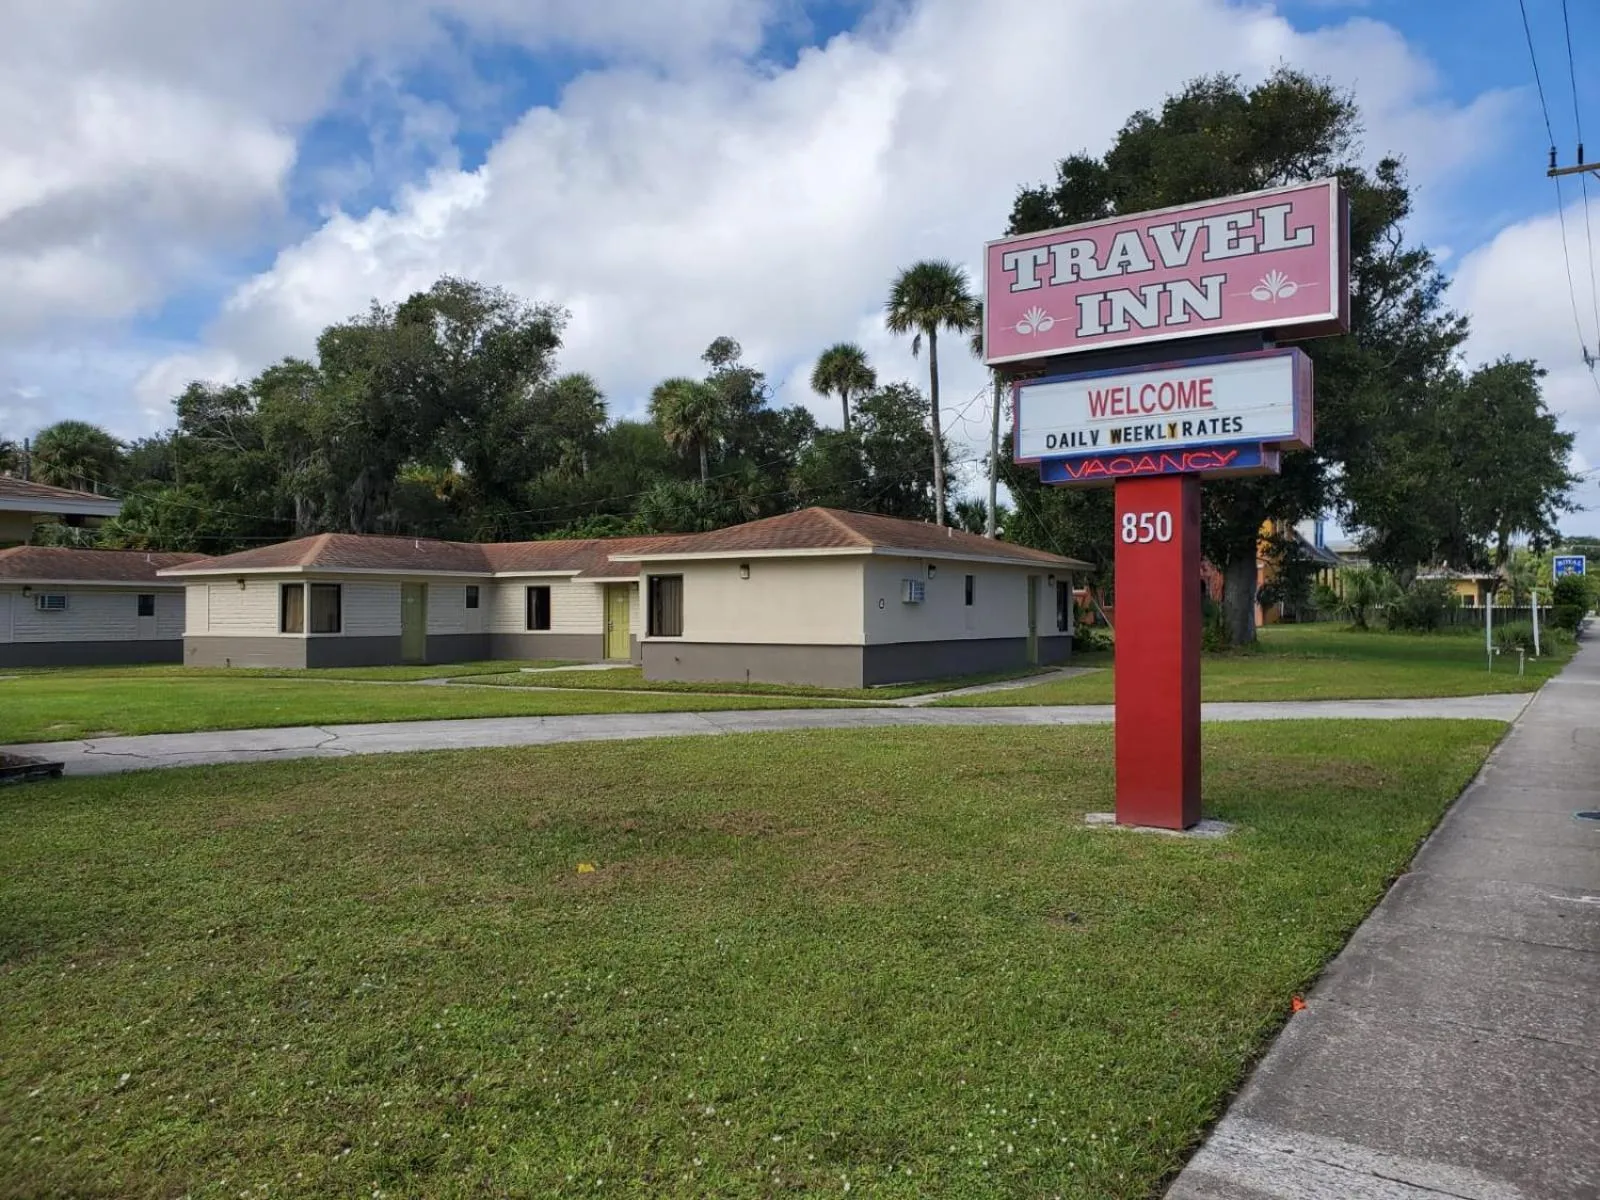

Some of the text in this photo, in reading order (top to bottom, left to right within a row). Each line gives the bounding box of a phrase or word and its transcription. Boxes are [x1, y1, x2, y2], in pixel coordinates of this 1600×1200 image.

[1002, 202, 1314, 293] TRAVEL
[1075, 273, 1227, 338] INN
[1088, 378, 1214, 417] WELCOME
[1109, 422, 1177, 444] WEEKLY
[1182, 416, 1243, 436] RATES
[1065, 449, 1237, 478] VACANCY
[1121, 510, 1172, 543] 850
